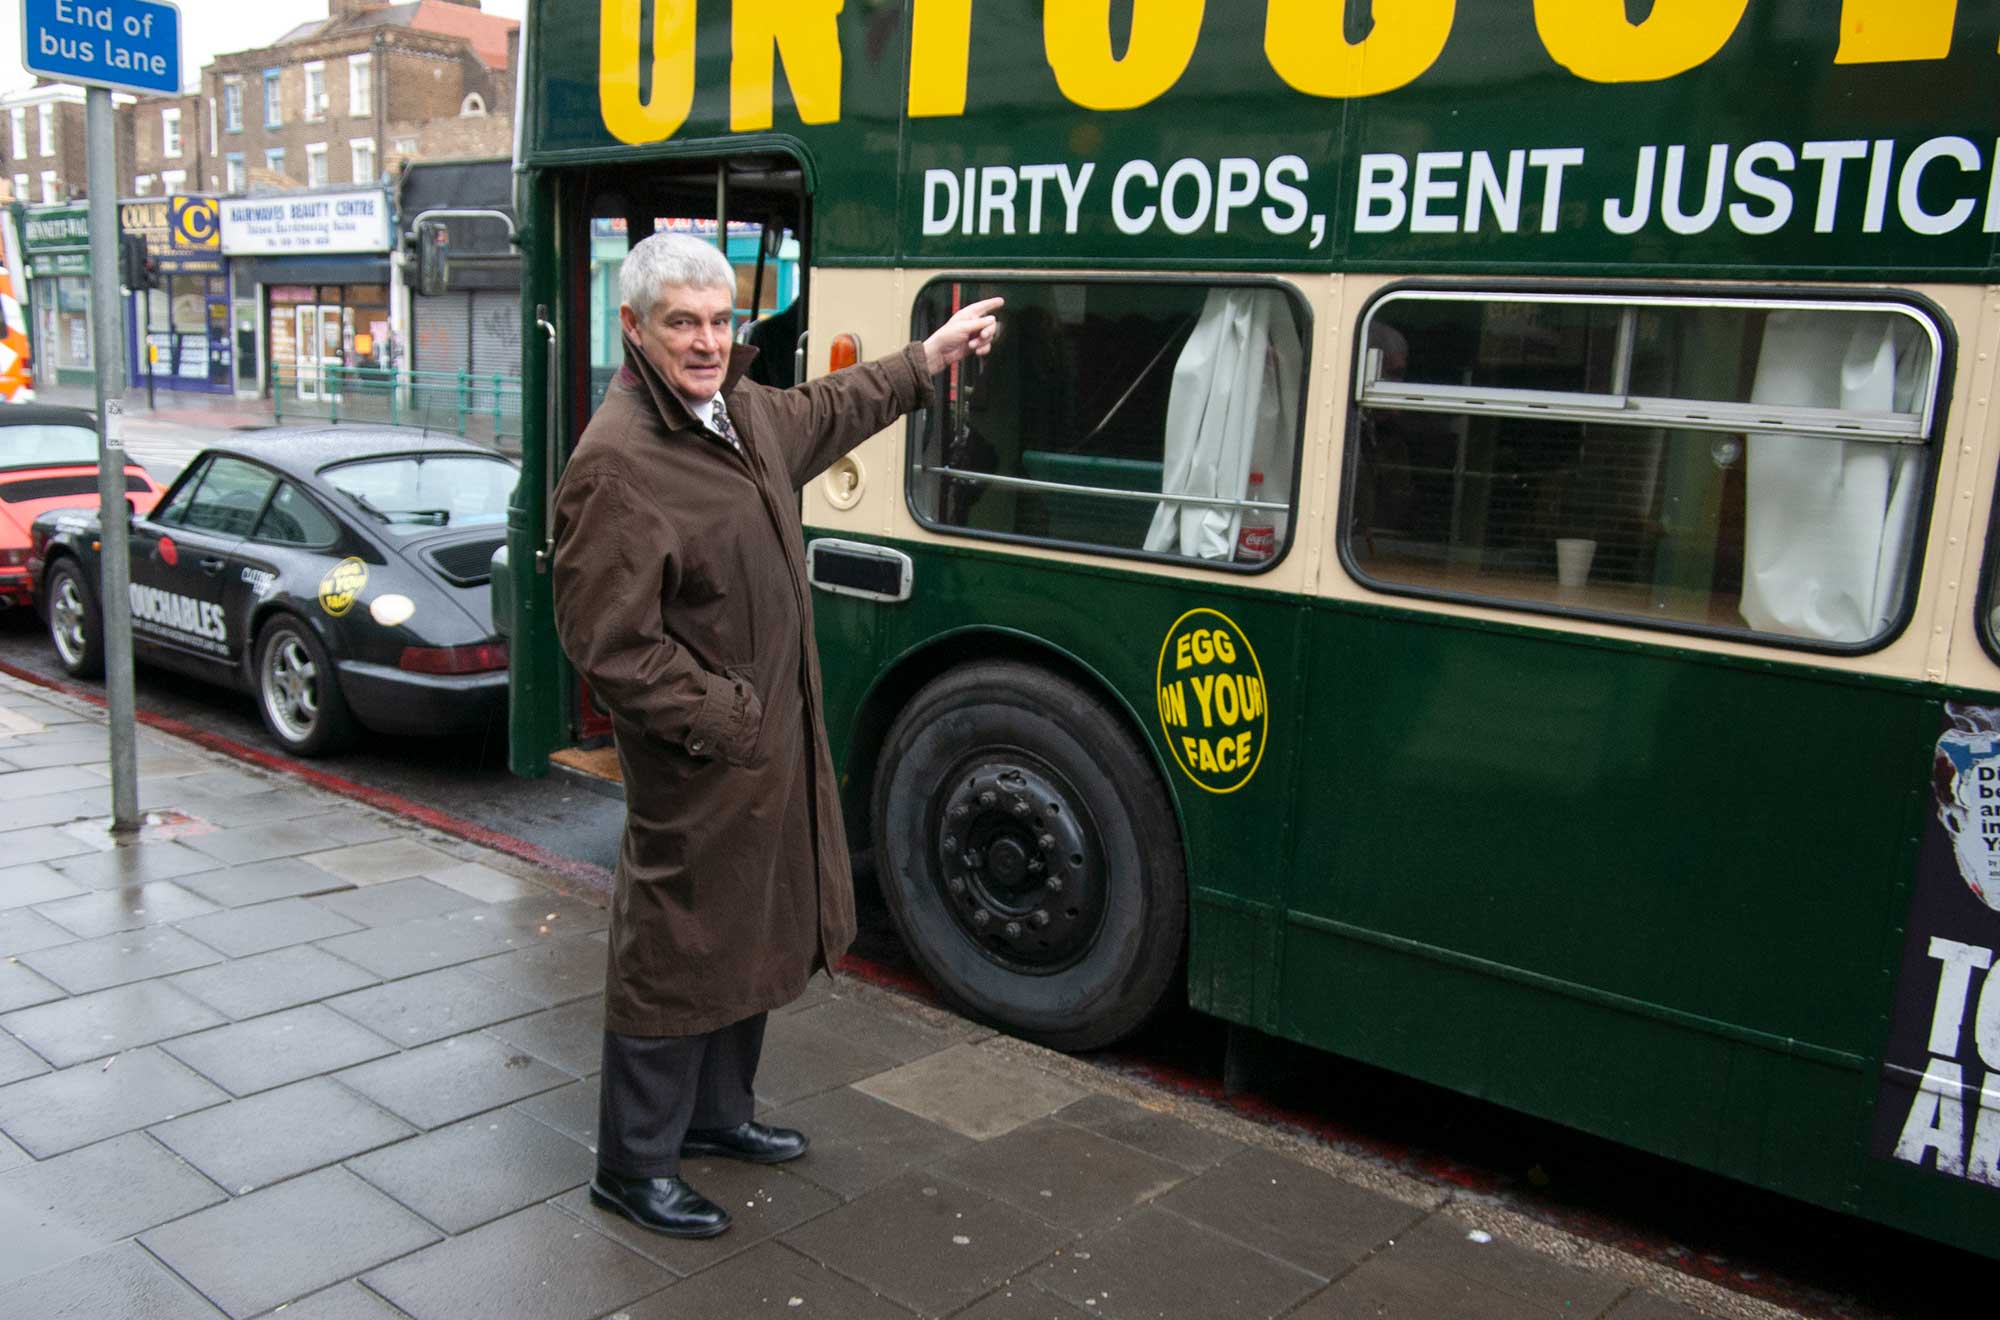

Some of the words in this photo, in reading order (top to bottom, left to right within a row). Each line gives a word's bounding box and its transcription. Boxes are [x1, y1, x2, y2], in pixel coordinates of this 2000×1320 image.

[55, 0, 113, 31] End
[123, 13, 154, 39] of
[39, 26, 95, 63] bus
[105, 39, 167, 76] lane
[290, 202, 329, 219] BEAUTY
[922, 161, 1096, 237] DIRTY
[1111, 154, 1326, 249] COPS,
[1353, 147, 1584, 234] BENT
[128, 582, 227, 642] OUCHABLES
[1176, 628, 1237, 671] EGG
[1162, 680, 1188, 728] ON
[1190, 673, 1264, 728] YOUR
[1181, 731, 1253, 774] FACE
